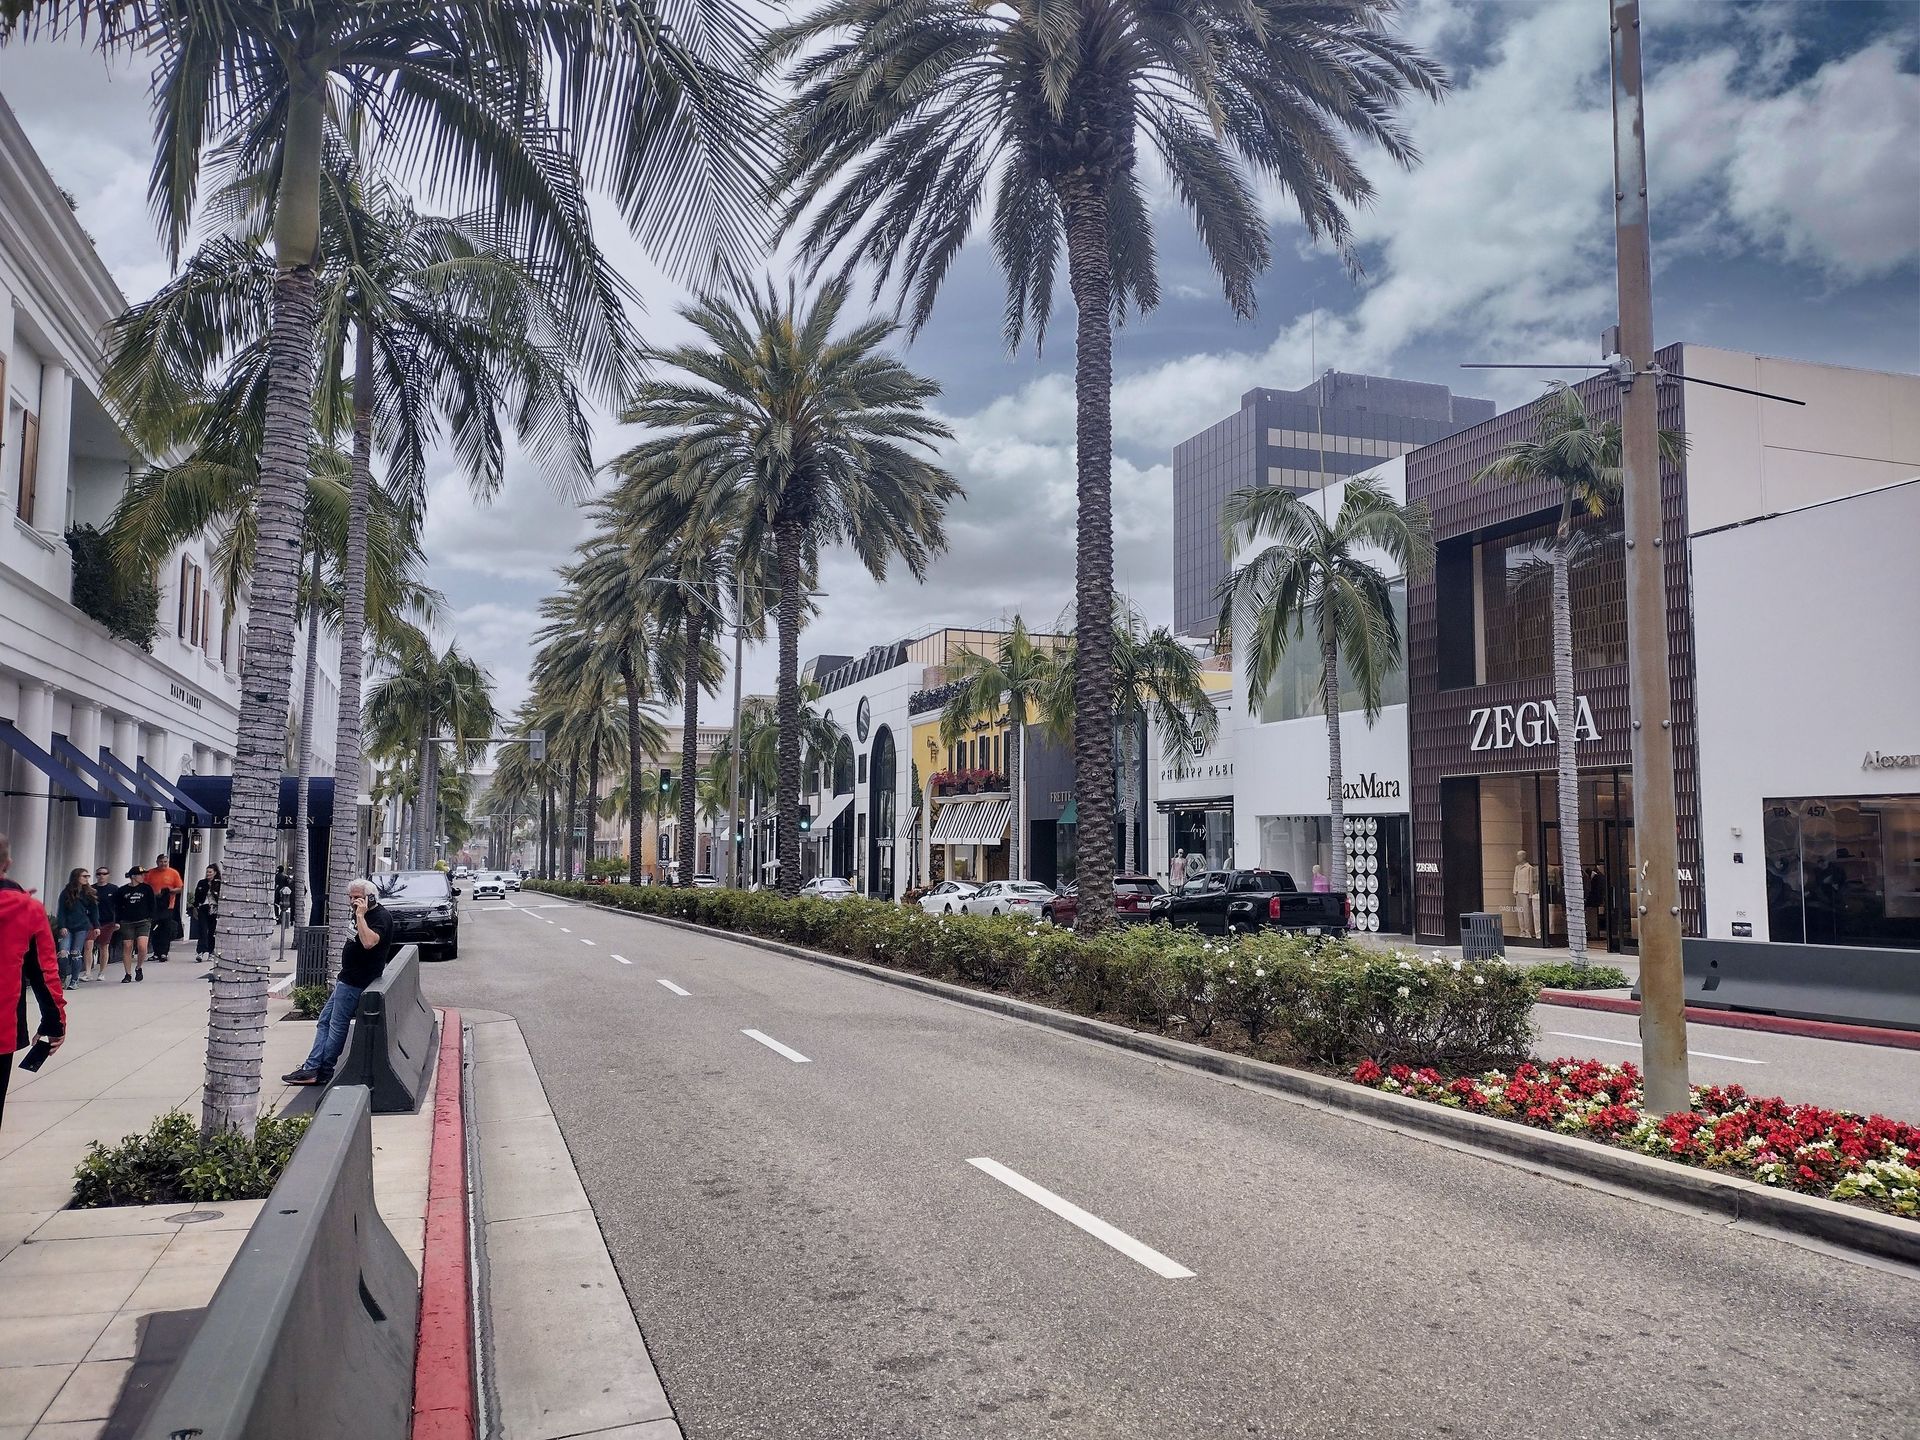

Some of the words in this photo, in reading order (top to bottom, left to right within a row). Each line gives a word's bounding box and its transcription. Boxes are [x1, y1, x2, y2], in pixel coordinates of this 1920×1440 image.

[1468, 695, 1602, 751] ZEGNA
[1807, 806, 1826, 817] 457
[1415, 862, 1440, 873] ZEGNA
